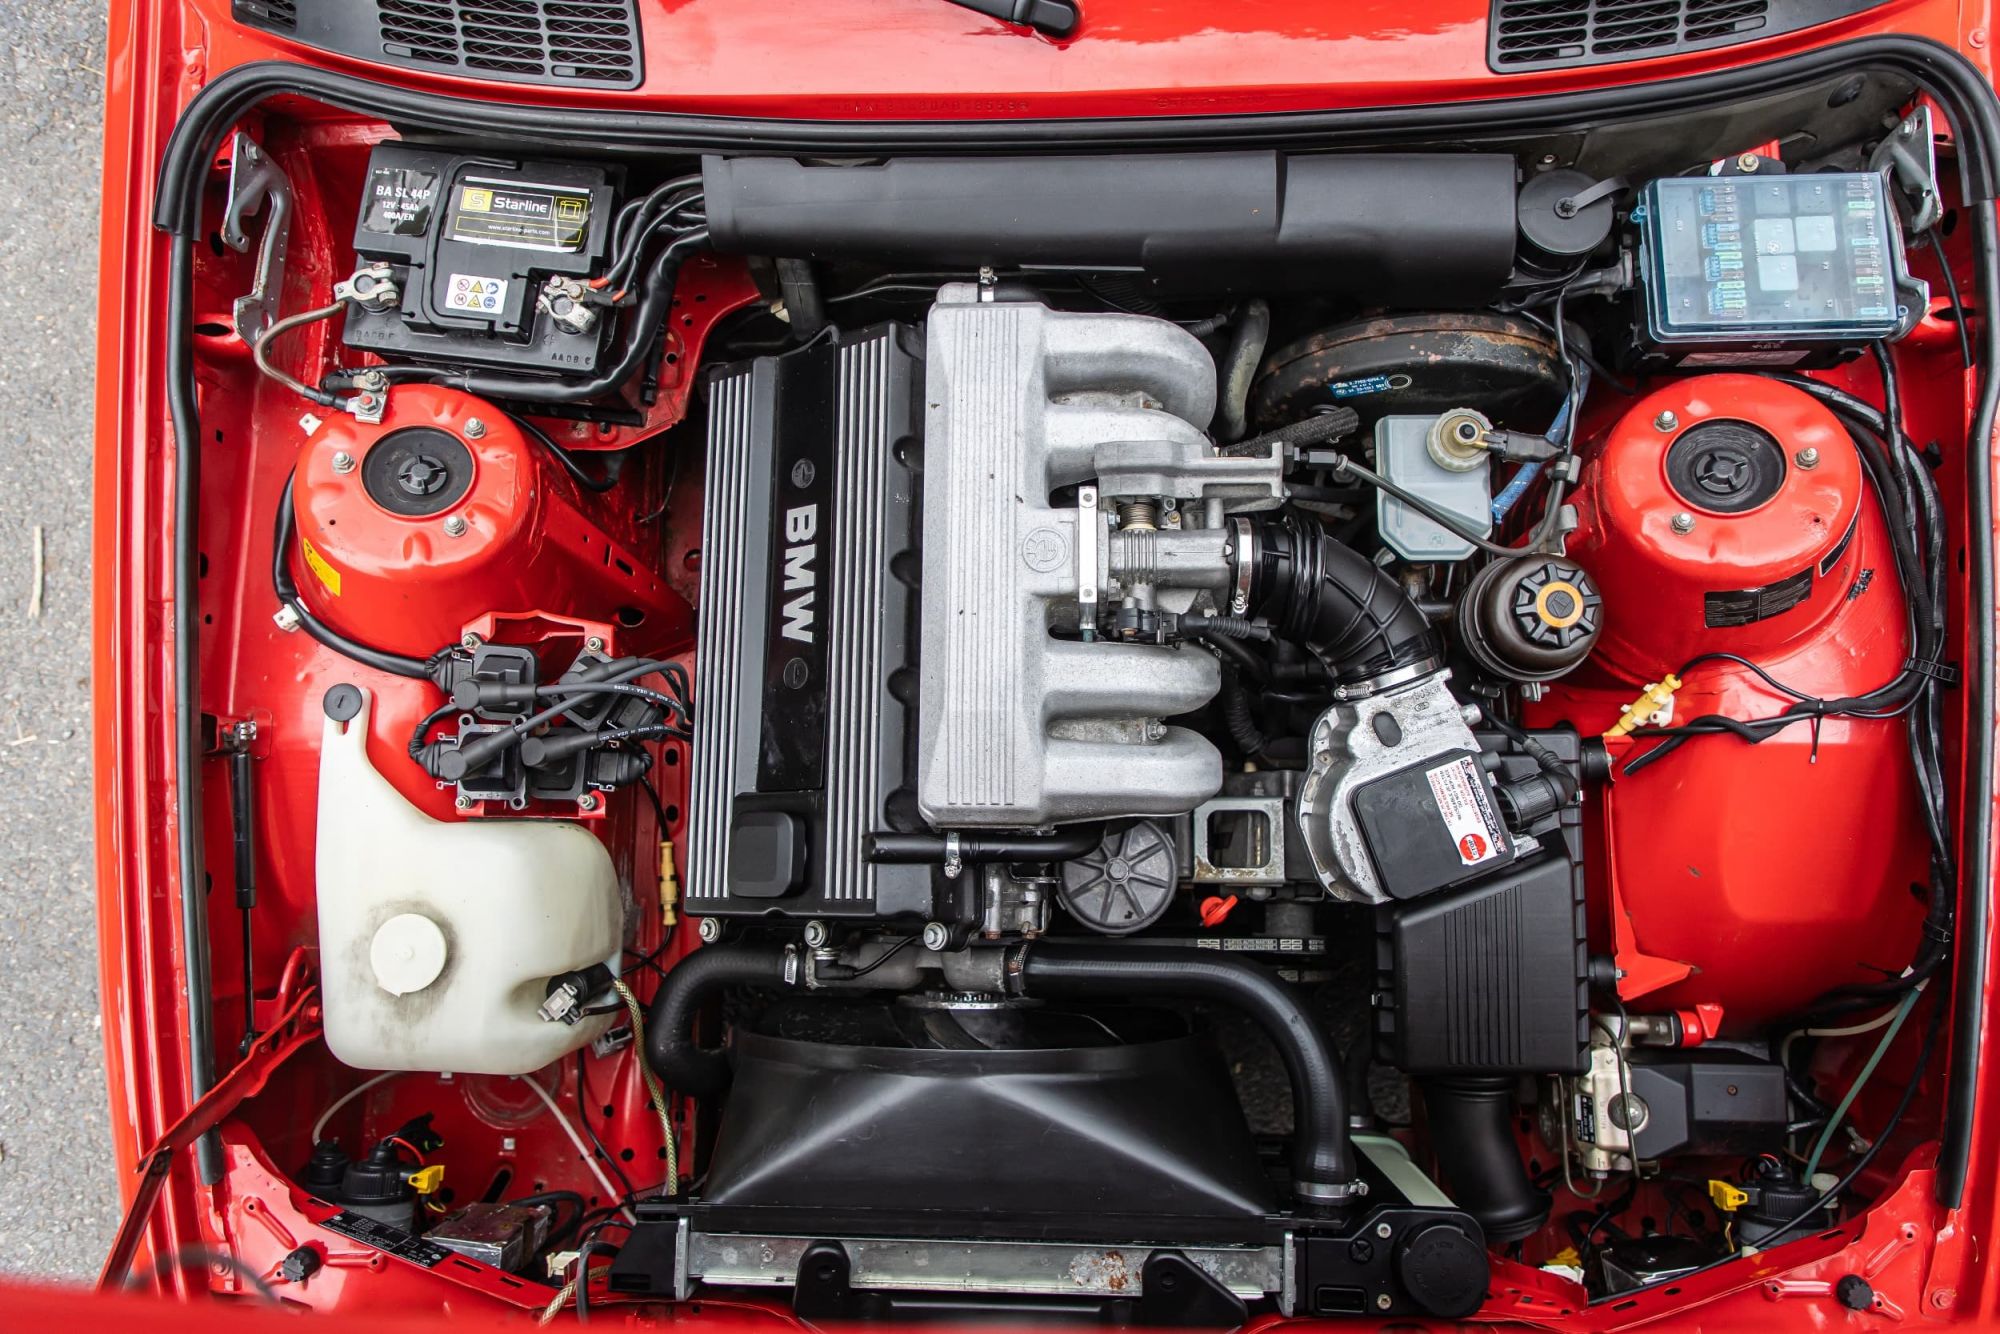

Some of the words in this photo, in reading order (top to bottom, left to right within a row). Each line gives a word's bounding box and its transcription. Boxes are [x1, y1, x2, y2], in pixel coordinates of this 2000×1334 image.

[376, 185, 392, 196] BA
[395, 187, 408, 198] SL
[411, 189, 430, 200] 44P
[494, 197, 548, 213] Starline
[488, 224, 550, 236] www.starline-parts.com
[782, 503, 817, 643] BMW
[1467, 838, 1478, 856] STOP
